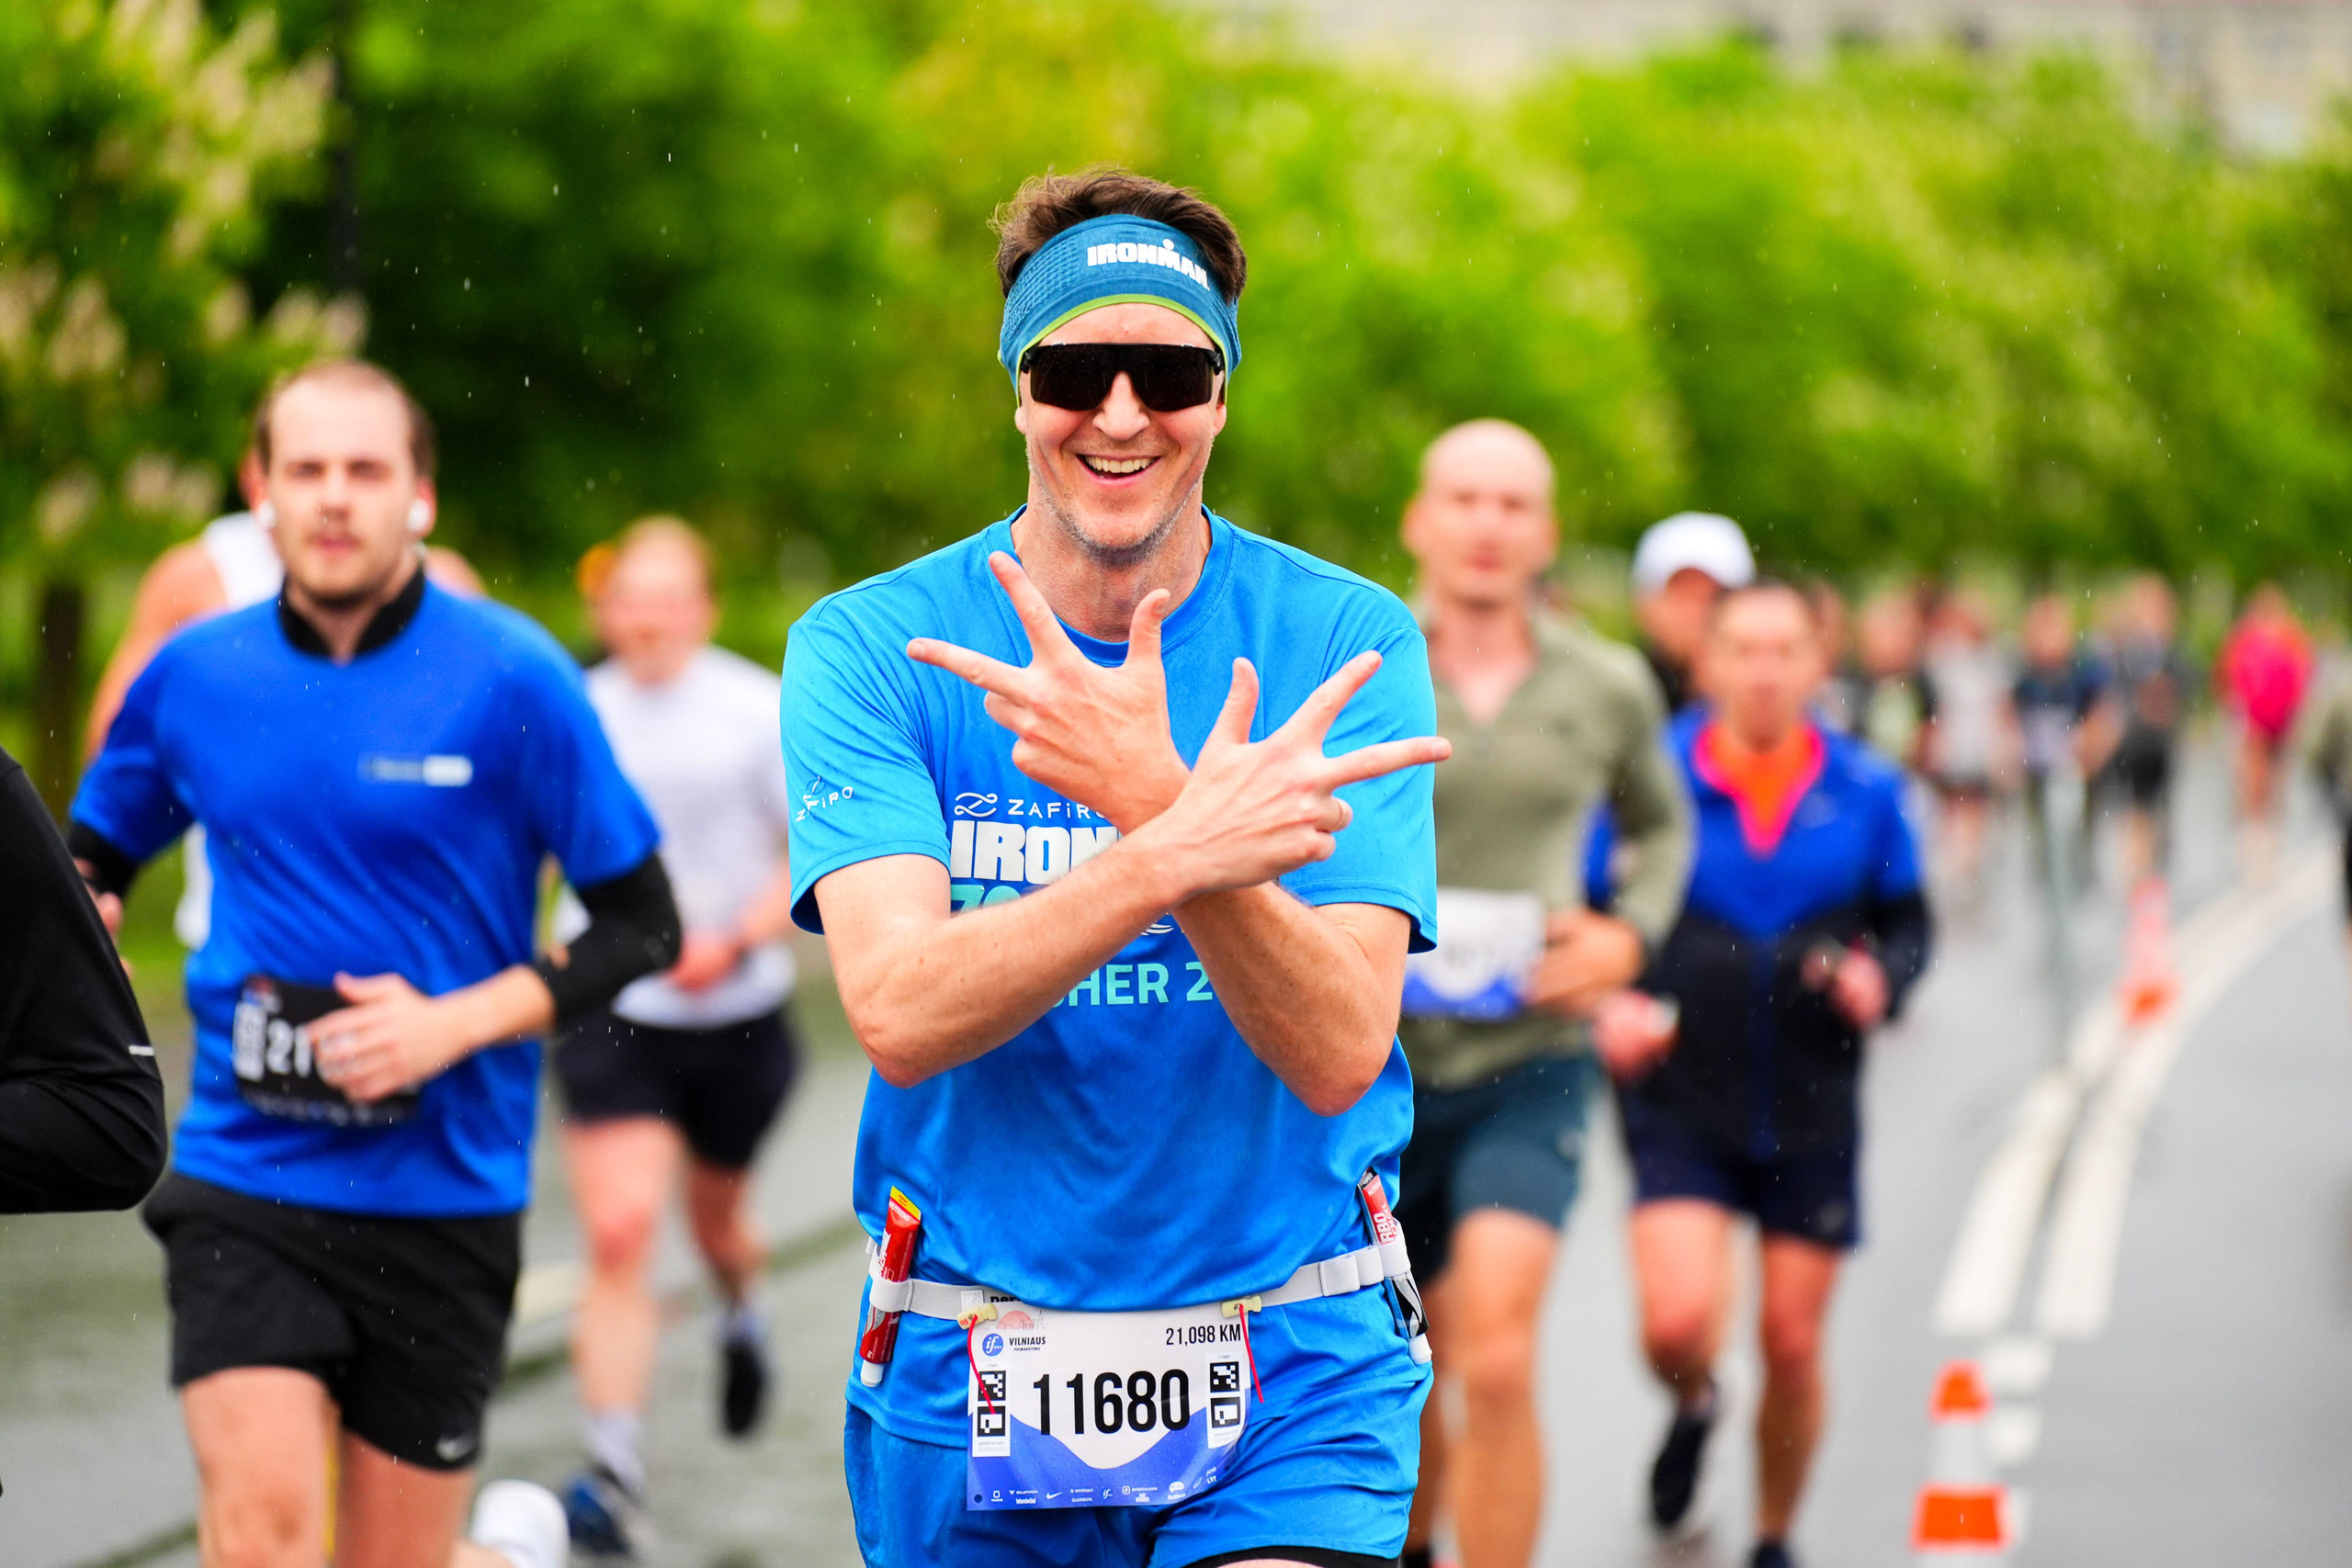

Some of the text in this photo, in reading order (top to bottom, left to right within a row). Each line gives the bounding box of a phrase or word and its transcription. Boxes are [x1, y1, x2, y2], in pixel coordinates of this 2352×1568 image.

[1087, 239, 1211, 291] IRONMAN
[950, 819, 1124, 886] IRON
[1052, 963, 1169, 1008] HER
[1373, 1212, 1396, 1244] RBO
[1009, 1337, 1046, 1346] VILNIAUS
[1166, 1324, 1241, 1347] 21,098 KM
[1034, 1369, 1190, 1436] 11680
